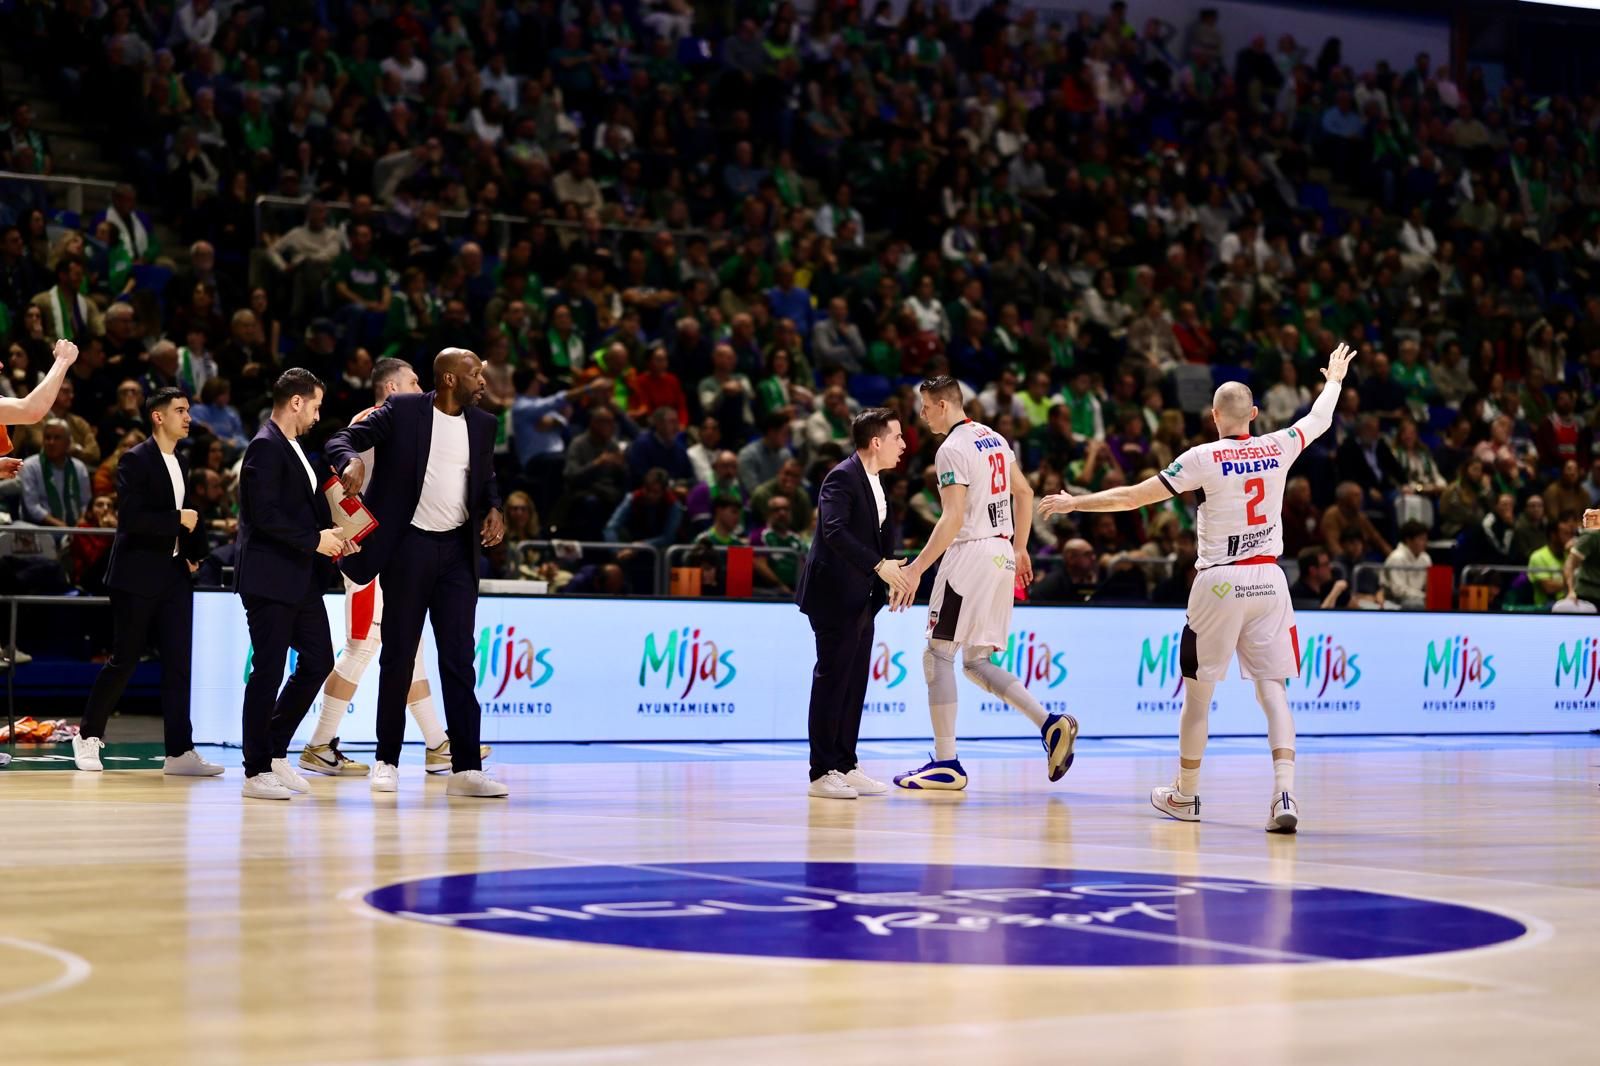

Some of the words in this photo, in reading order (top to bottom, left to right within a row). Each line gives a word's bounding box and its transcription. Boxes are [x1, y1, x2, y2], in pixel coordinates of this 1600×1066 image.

[1212, 444, 1281, 463] ROUSSELLE
[1221, 458, 1279, 476] PULEVA
[1244, 477, 1267, 526] 2
[1234, 583, 1274, 592] Diputación
[1246, 590, 1276, 598] Granada
[639, 626, 737, 700] Mijas
[1423, 635, 1496, 698] Mijas
[1555, 637, 1600, 698] Mij
[480, 703, 552, 714] TAMIENTO
[637, 703, 735, 714] AYUNTAMIENTO
[863, 702, 906, 713] MIENTO
[1289, 701, 1361, 712] YUNTAMIENTO
[1423, 701, 1496, 711] AYUNTAMIENTO
